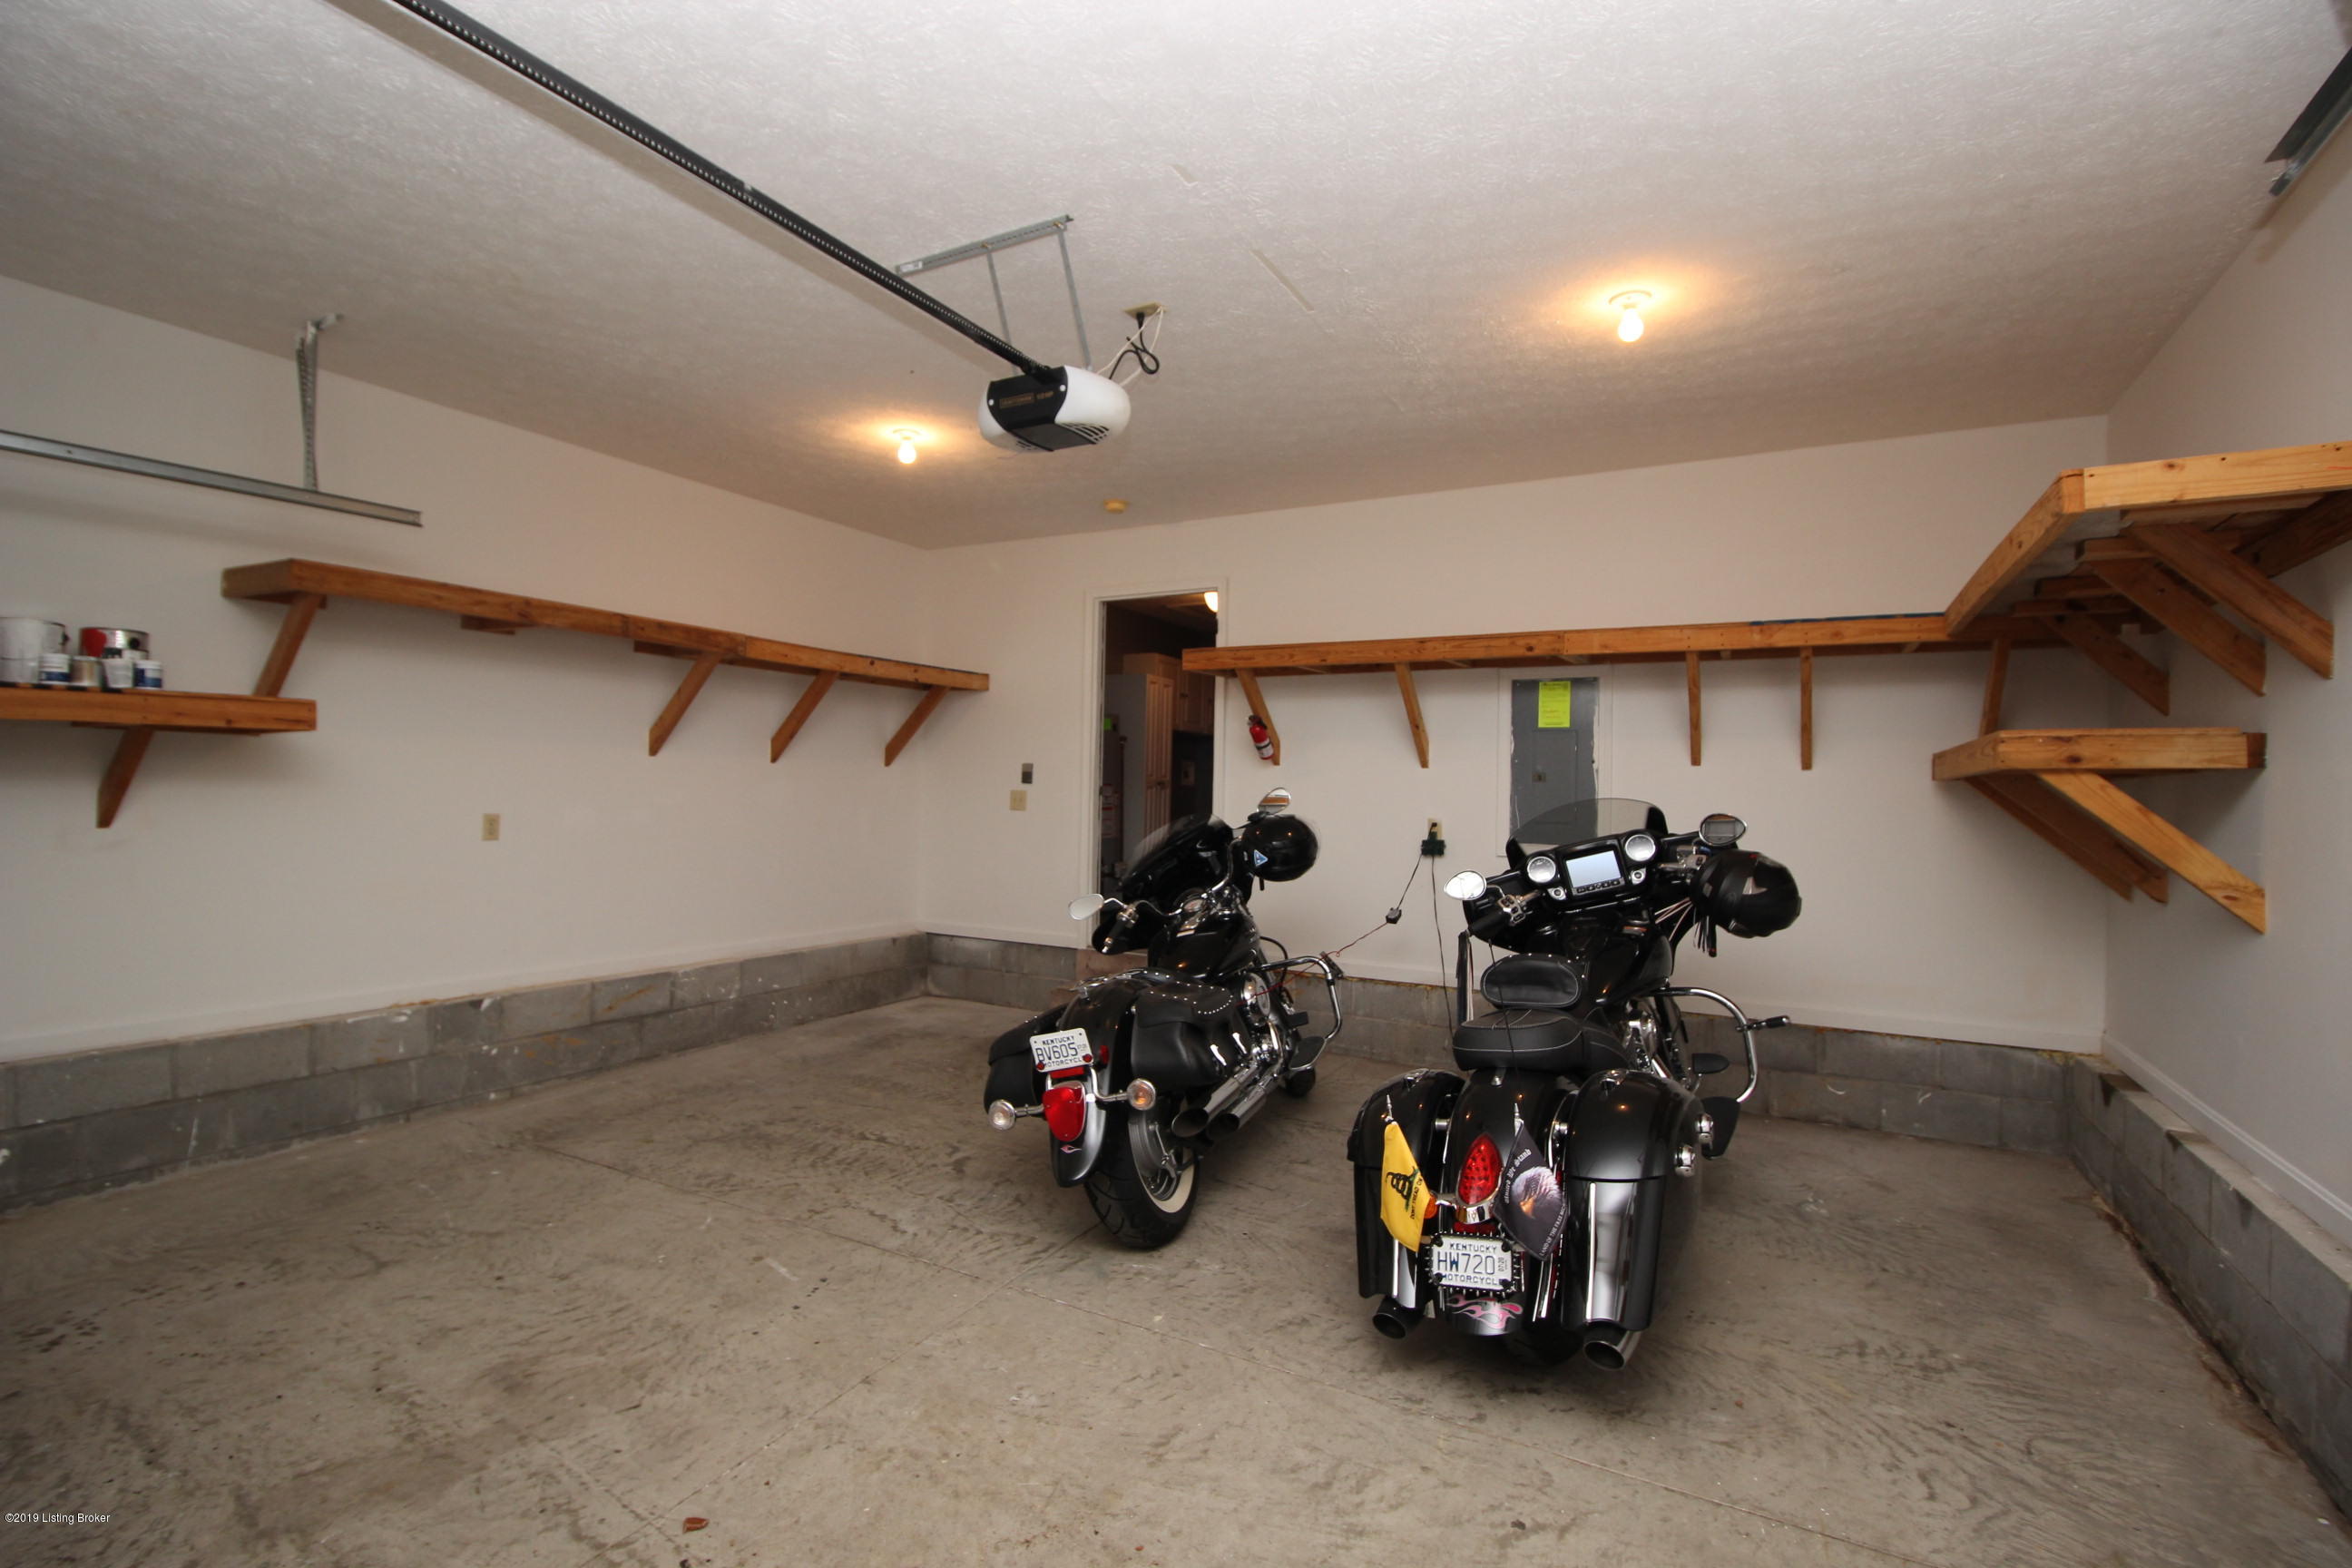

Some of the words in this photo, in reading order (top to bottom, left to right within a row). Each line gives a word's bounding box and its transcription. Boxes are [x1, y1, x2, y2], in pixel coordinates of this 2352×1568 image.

[1042, 1035, 1074, 1045] KENTUCKY
[1035, 1042, 1078, 1063] BV605
[1043, 1057, 1085, 1068] MOTORCYCL
[1514, 1148, 1532, 1167] Stand
[1449, 1243, 1497, 1253] KENTUCKY
[1437, 1251, 1495, 1275] HW720
